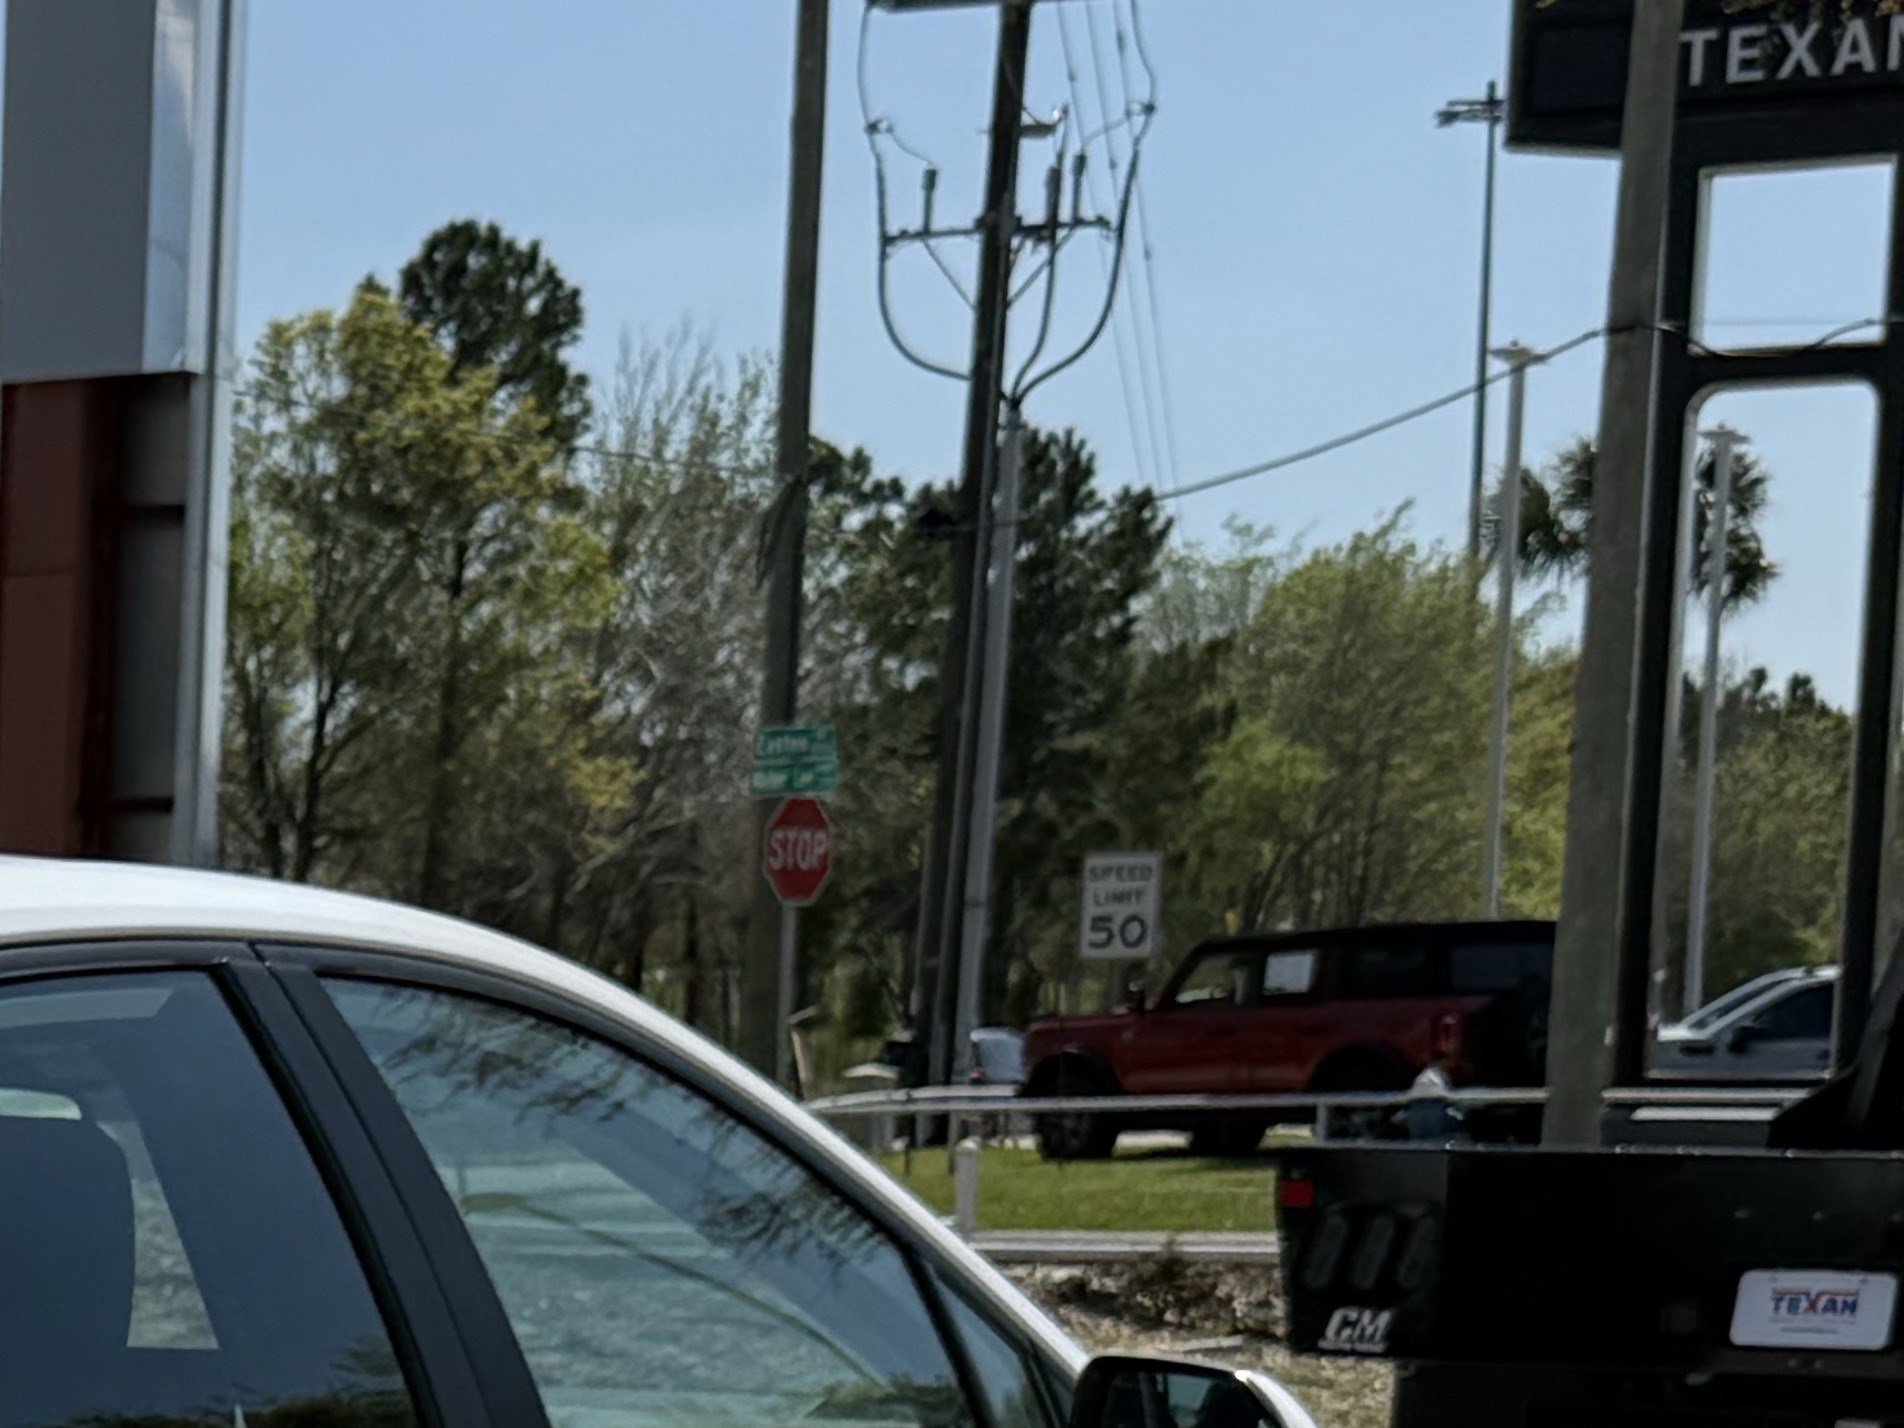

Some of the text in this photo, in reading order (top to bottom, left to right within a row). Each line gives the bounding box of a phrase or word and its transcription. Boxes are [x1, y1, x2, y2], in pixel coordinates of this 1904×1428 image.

[769, 827, 828, 871] STOP
[1088, 864, 1153, 882] SPEED
[1087, 913, 1148, 949] 50
[1324, 1305, 1391, 1343] CM
